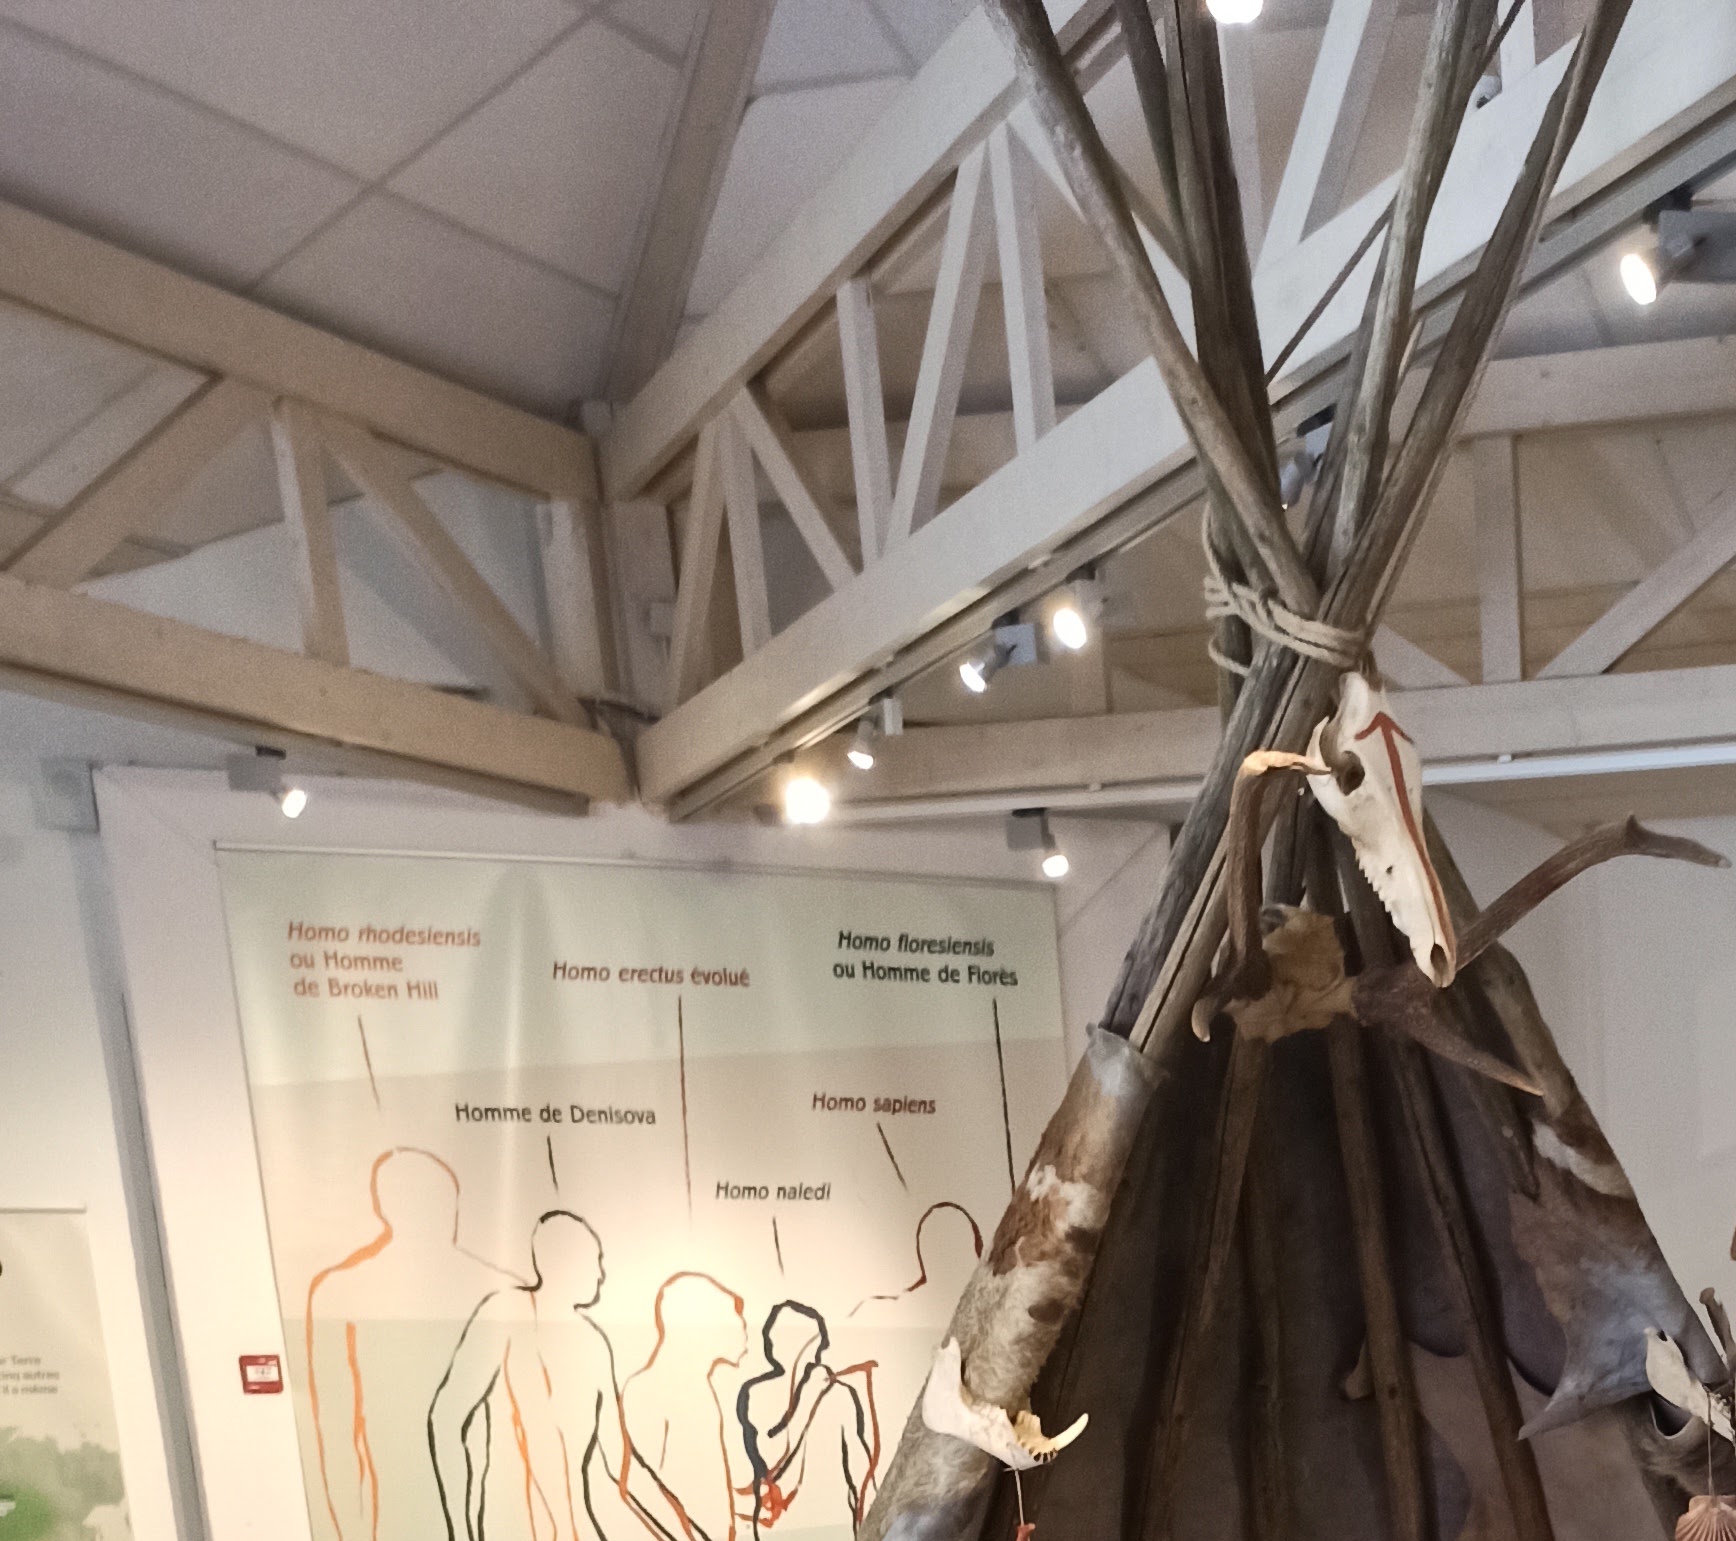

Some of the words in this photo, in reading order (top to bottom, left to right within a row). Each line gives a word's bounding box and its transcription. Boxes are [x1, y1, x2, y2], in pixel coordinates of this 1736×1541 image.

[288, 921, 349, 942] Homo
[358, 924, 480, 946] rhodesiensis
[838, 930, 890, 951] Homo
[899, 934, 994, 956] floresiensis
[290, 954, 315, 968] ou
[323, 951, 403, 971] Homme
[833, 963, 855, 978] ou
[862, 961, 930, 983] Homme
[938, 965, 960, 983] de
[553, 961, 610, 981] Homo
[619, 966, 684, 984] erectus
[691, 967, 749, 986] évolué
[294, 978, 319, 997] de
[328, 978, 398, 999] Broken
[407, 980, 438, 999] Hill
[455, 1103, 532, 1122] Homme
[539, 1104, 562, 1123] de
[570, 1105, 656, 1124] Denisova
[812, 1092, 866, 1112] Homo
[873, 1096, 936, 1114] sapiens
[716, 1181, 769, 1200] Homo
[777, 1182, 831, 1200] naledi
